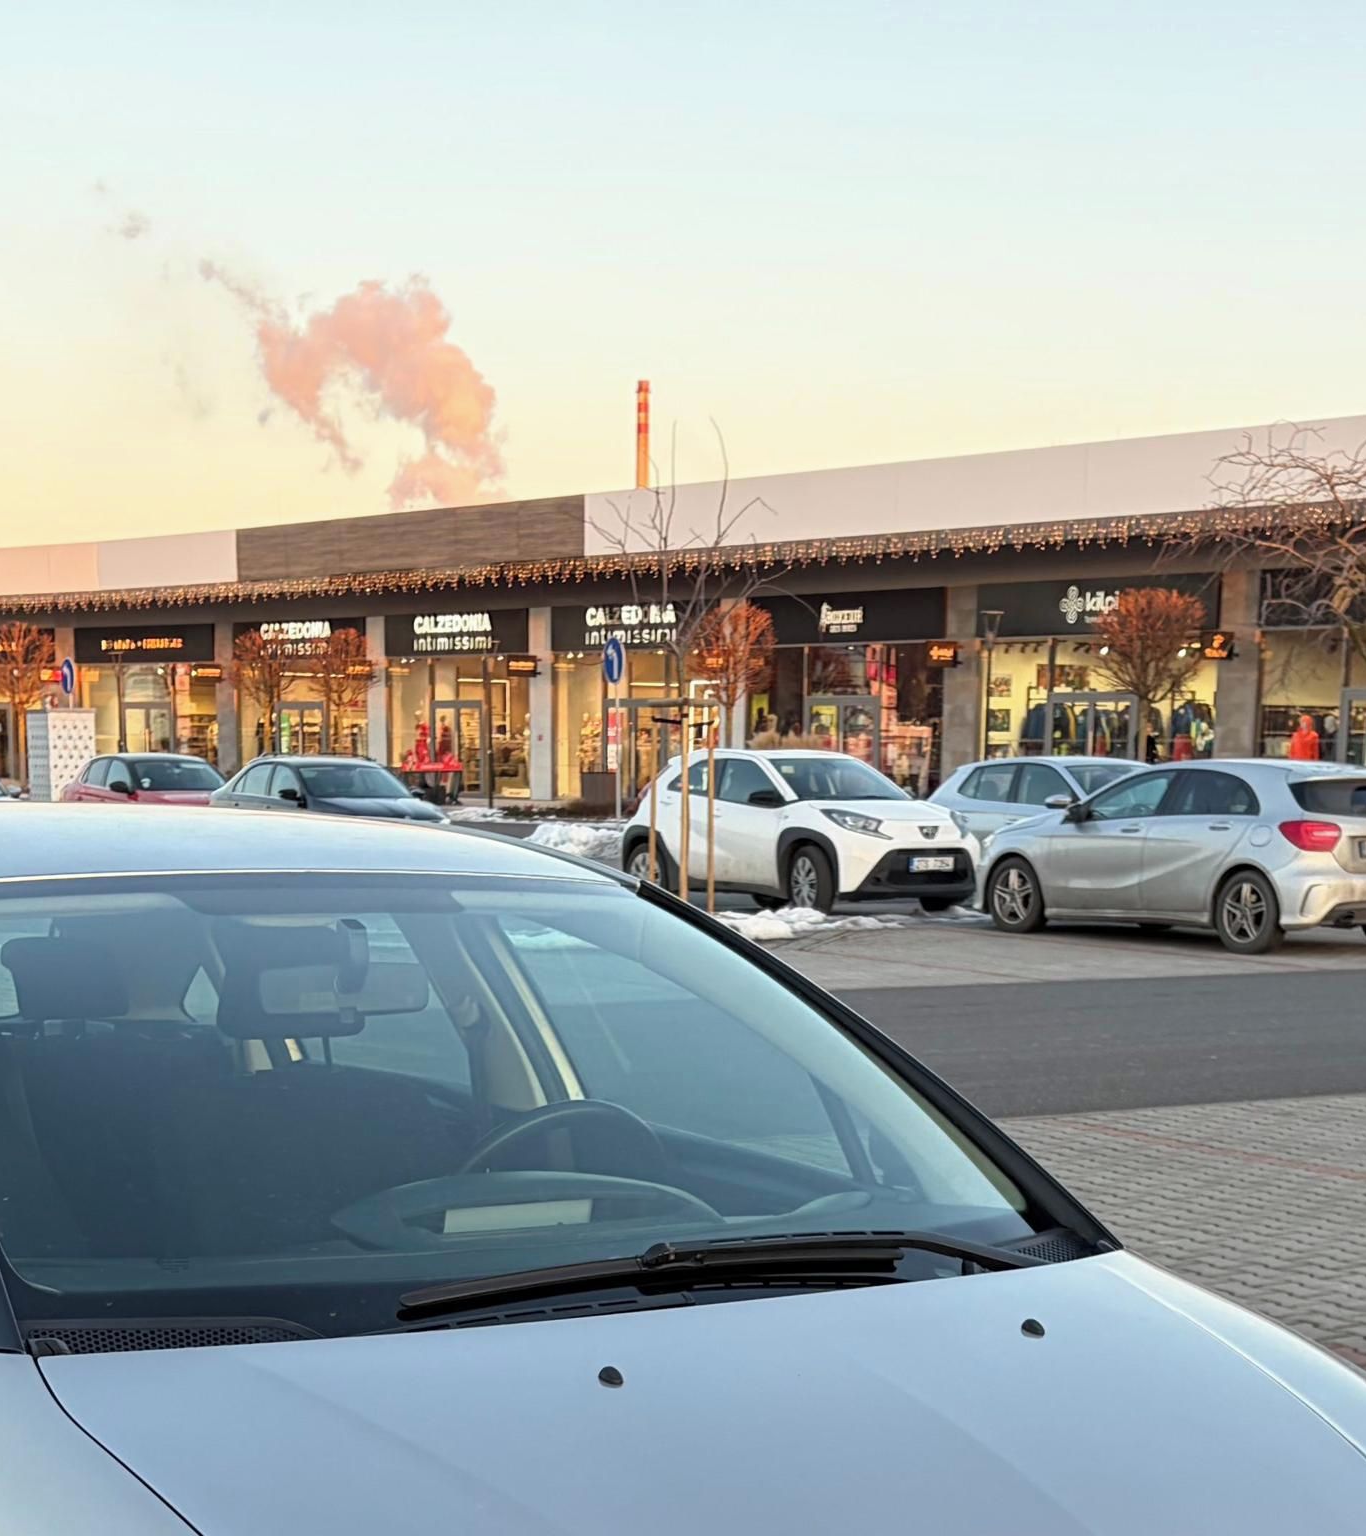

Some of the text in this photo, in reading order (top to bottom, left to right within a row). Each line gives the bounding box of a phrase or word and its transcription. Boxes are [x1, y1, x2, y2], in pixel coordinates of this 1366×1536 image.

[414, 613, 492, 634] CALZEDONIA
[585, 603, 677, 627] CALZEDONIA
[413, 636, 492, 651] intimissimi
[584, 627, 677, 645] intimissimi
